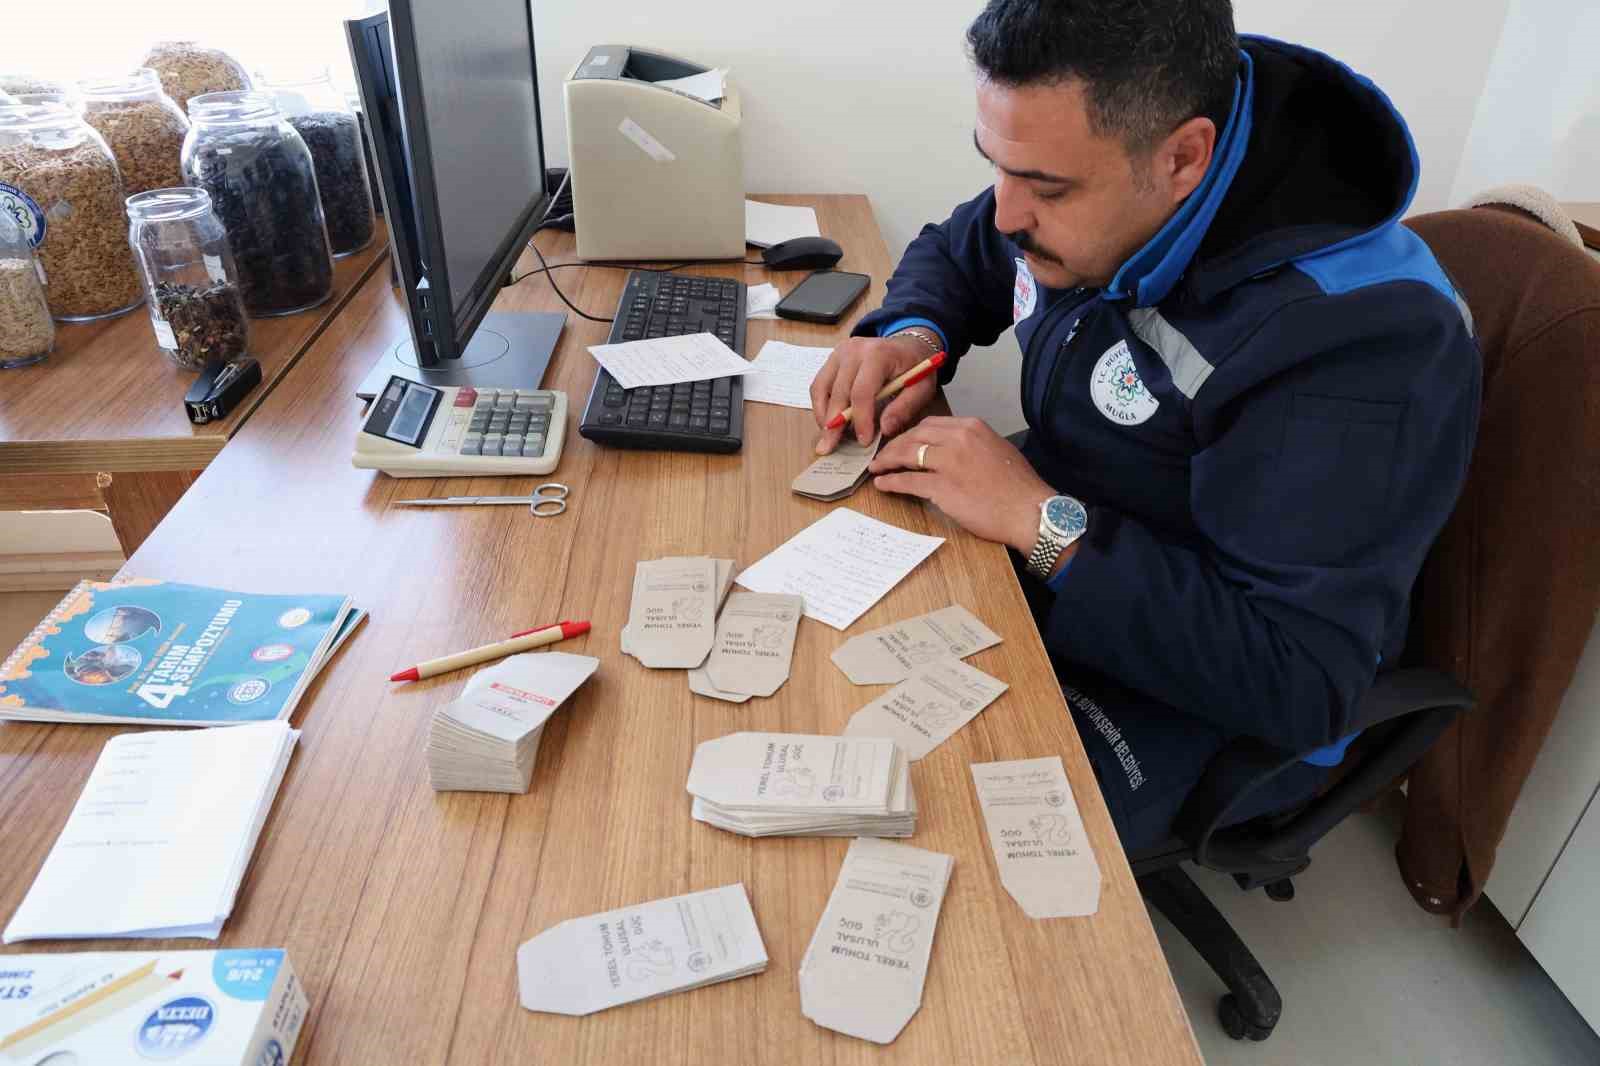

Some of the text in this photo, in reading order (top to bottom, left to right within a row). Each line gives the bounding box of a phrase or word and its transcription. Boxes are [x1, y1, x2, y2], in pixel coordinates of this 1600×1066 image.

[170, 599, 243, 684] SEMPOZYUMU
[152, 643, 191, 684] TARIM
[1113, 739, 1147, 791] BELEDİYESİ
[837, 932, 880, 948] ULUSAL
[831, 945, 910, 969] YEREL TOHUM
[157, 1006, 210, 1021] DELTA
